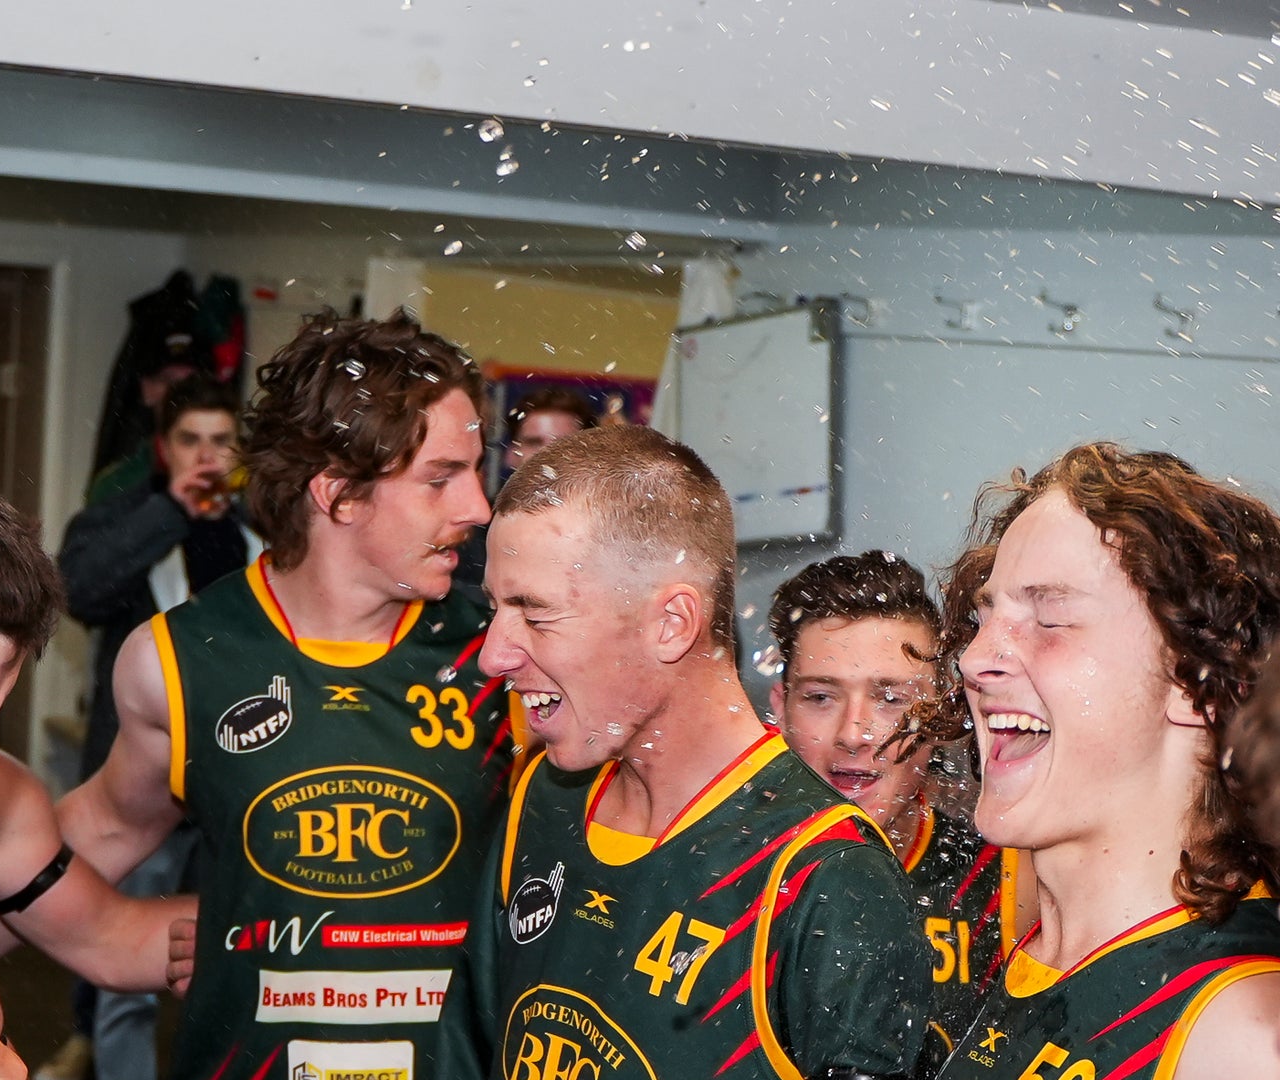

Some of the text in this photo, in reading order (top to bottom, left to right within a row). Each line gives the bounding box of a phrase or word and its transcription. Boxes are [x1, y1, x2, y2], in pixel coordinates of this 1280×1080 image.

[239, 711, 288, 747] NTFA
[406, 685, 475, 749] 33
[272, 780, 429, 812] BRIDGENORTH
[294, 803, 410, 863] BFC
[285, 860, 414, 884] FOOTBALL CLUB
[518, 907, 554, 936] NTFA
[573, 908, 615, 929] XBLADES
[331, 930, 360, 943] CNW
[363, 929, 417, 943] Electrical
[925, 917, 969, 984] 51
[633, 910, 726, 1006] 47
[263, 987, 315, 1007] BEAMS
[323, 988, 367, 1008] BROS
[376, 988, 407, 1007] PTY
[522, 1001, 626, 1070] BIDGENORTH
